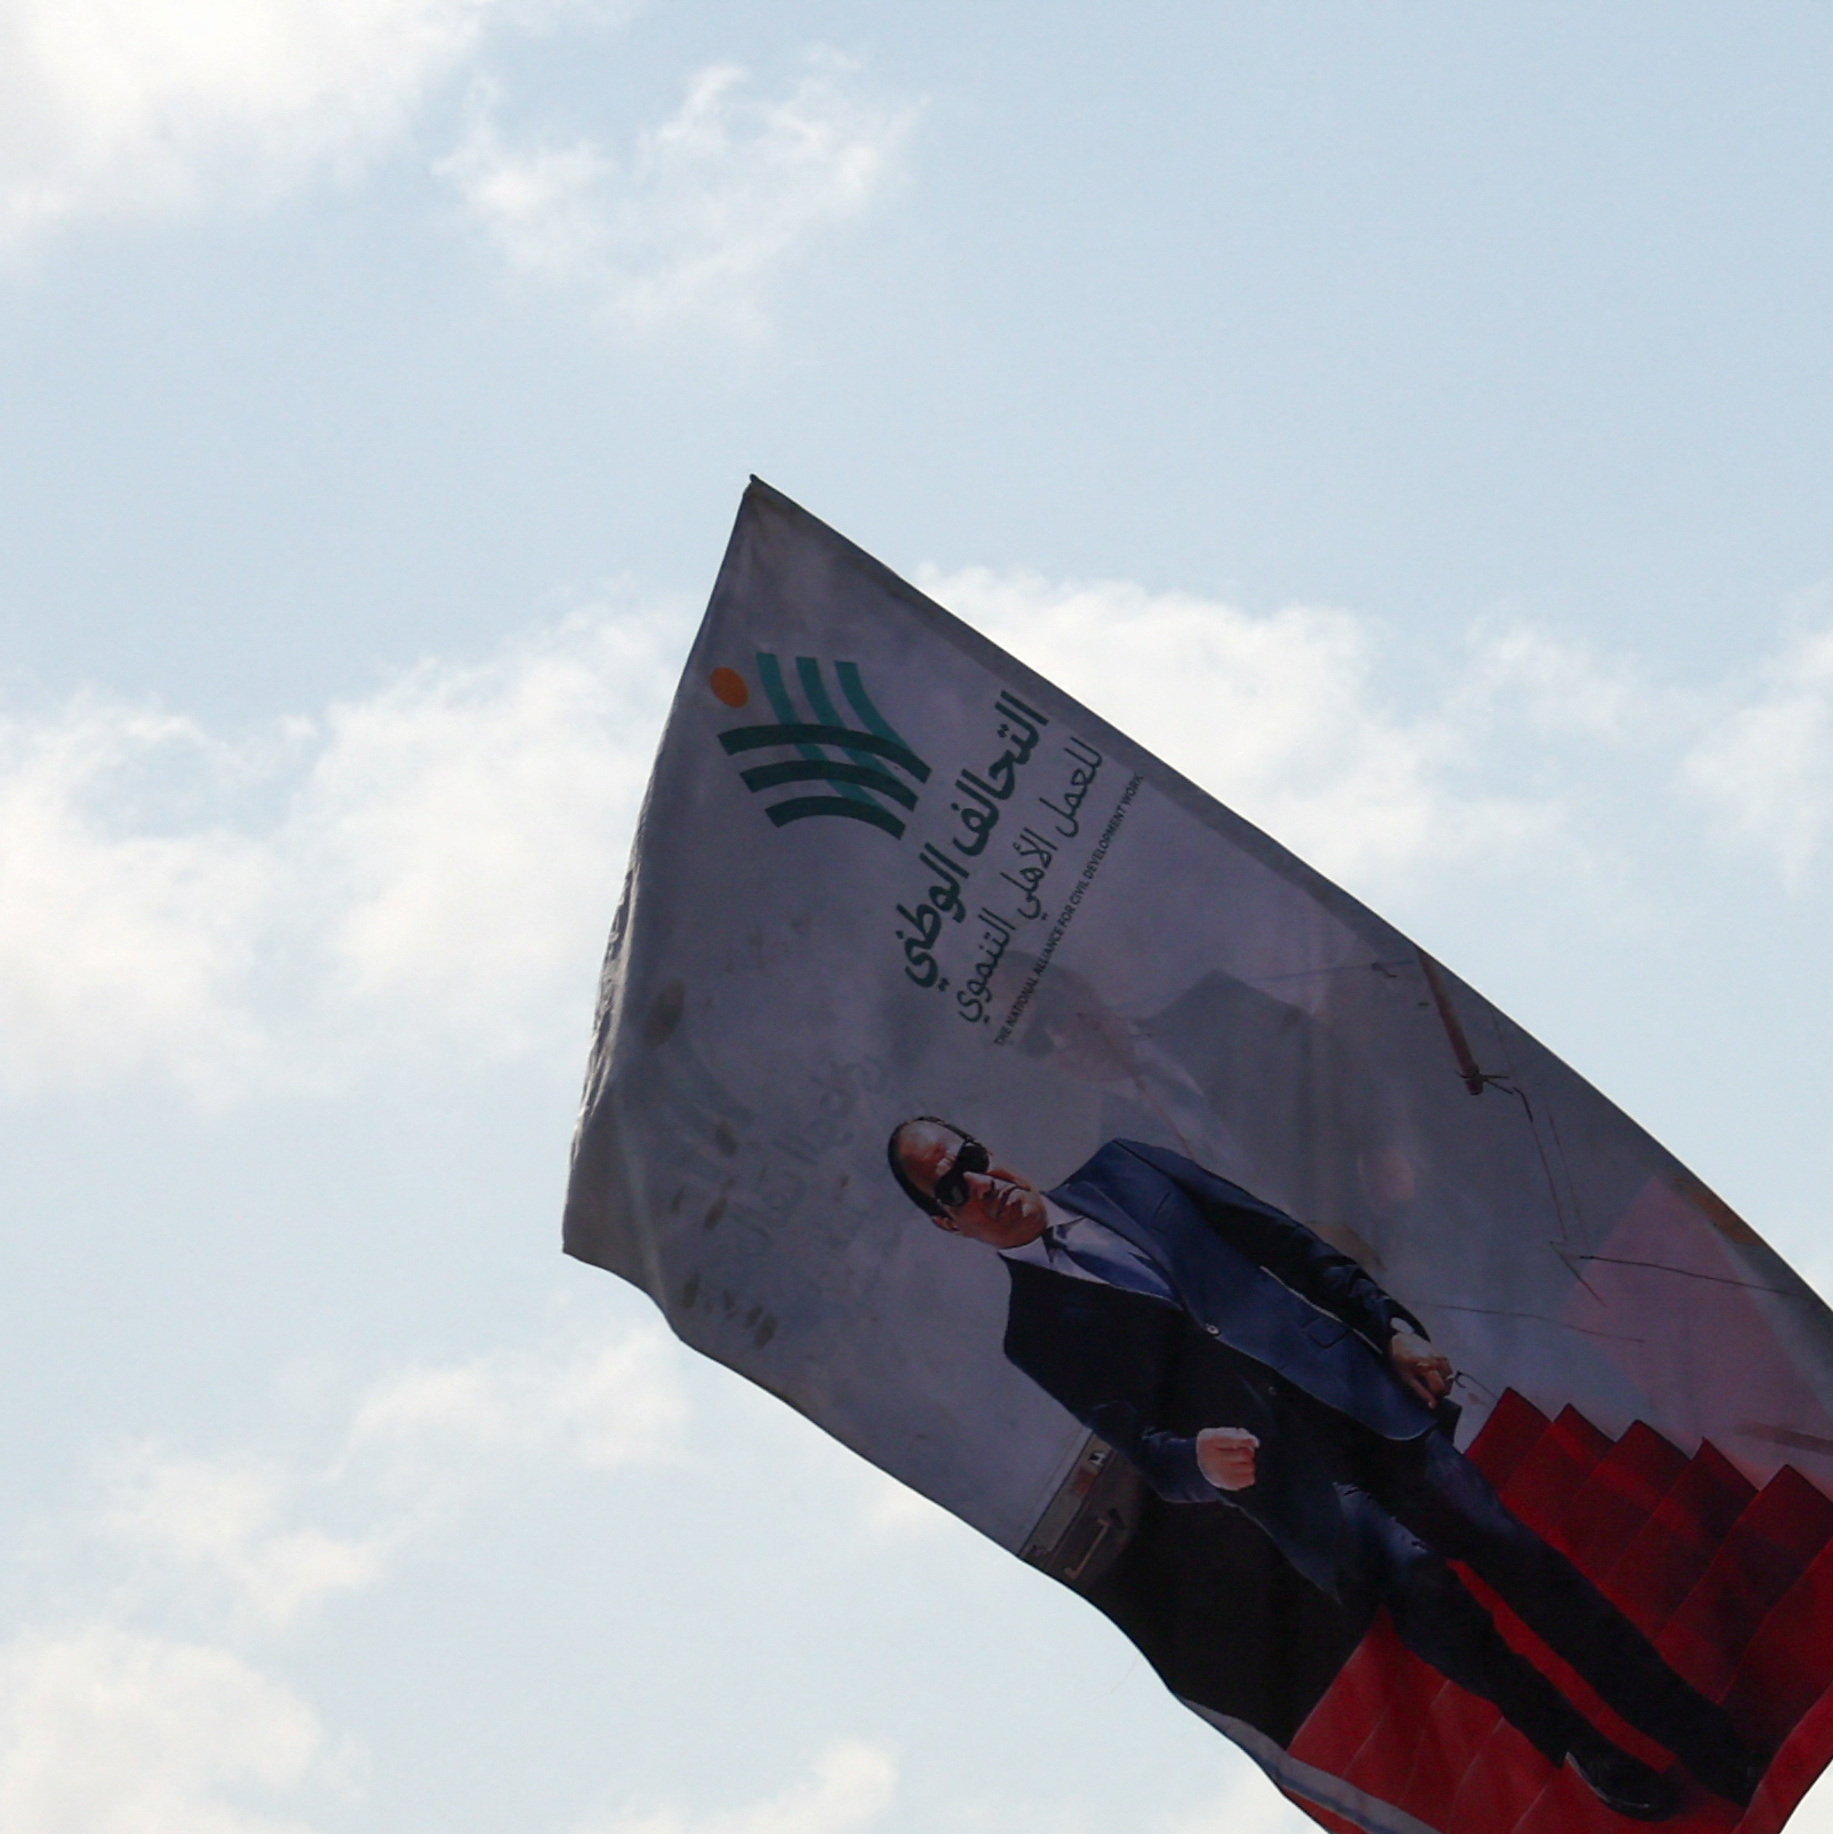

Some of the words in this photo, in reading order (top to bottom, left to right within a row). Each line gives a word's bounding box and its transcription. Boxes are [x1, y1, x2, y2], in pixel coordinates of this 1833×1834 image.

[954, 690, 1050, 857] التحالف
[1039, 737, 1104, 838] للعمل
[897, 843, 969, 993] الوطني
[994, 1024, 1012, 1046] THE
[1005, 976, 1038, 1027] NATIONAL
[1033, 925, 1064, 977] ALLIANCE
[1057, 904, 1075, 928] FOR
[1069, 881, 1090, 906] CIVIL
[1083, 804, 1126, 881] DEVELOPMENT
[1120, 771, 1144, 807] WORK
[1000, 828, 1057, 920] الأهلي
[957, 907, 1015, 1024] التنموي
